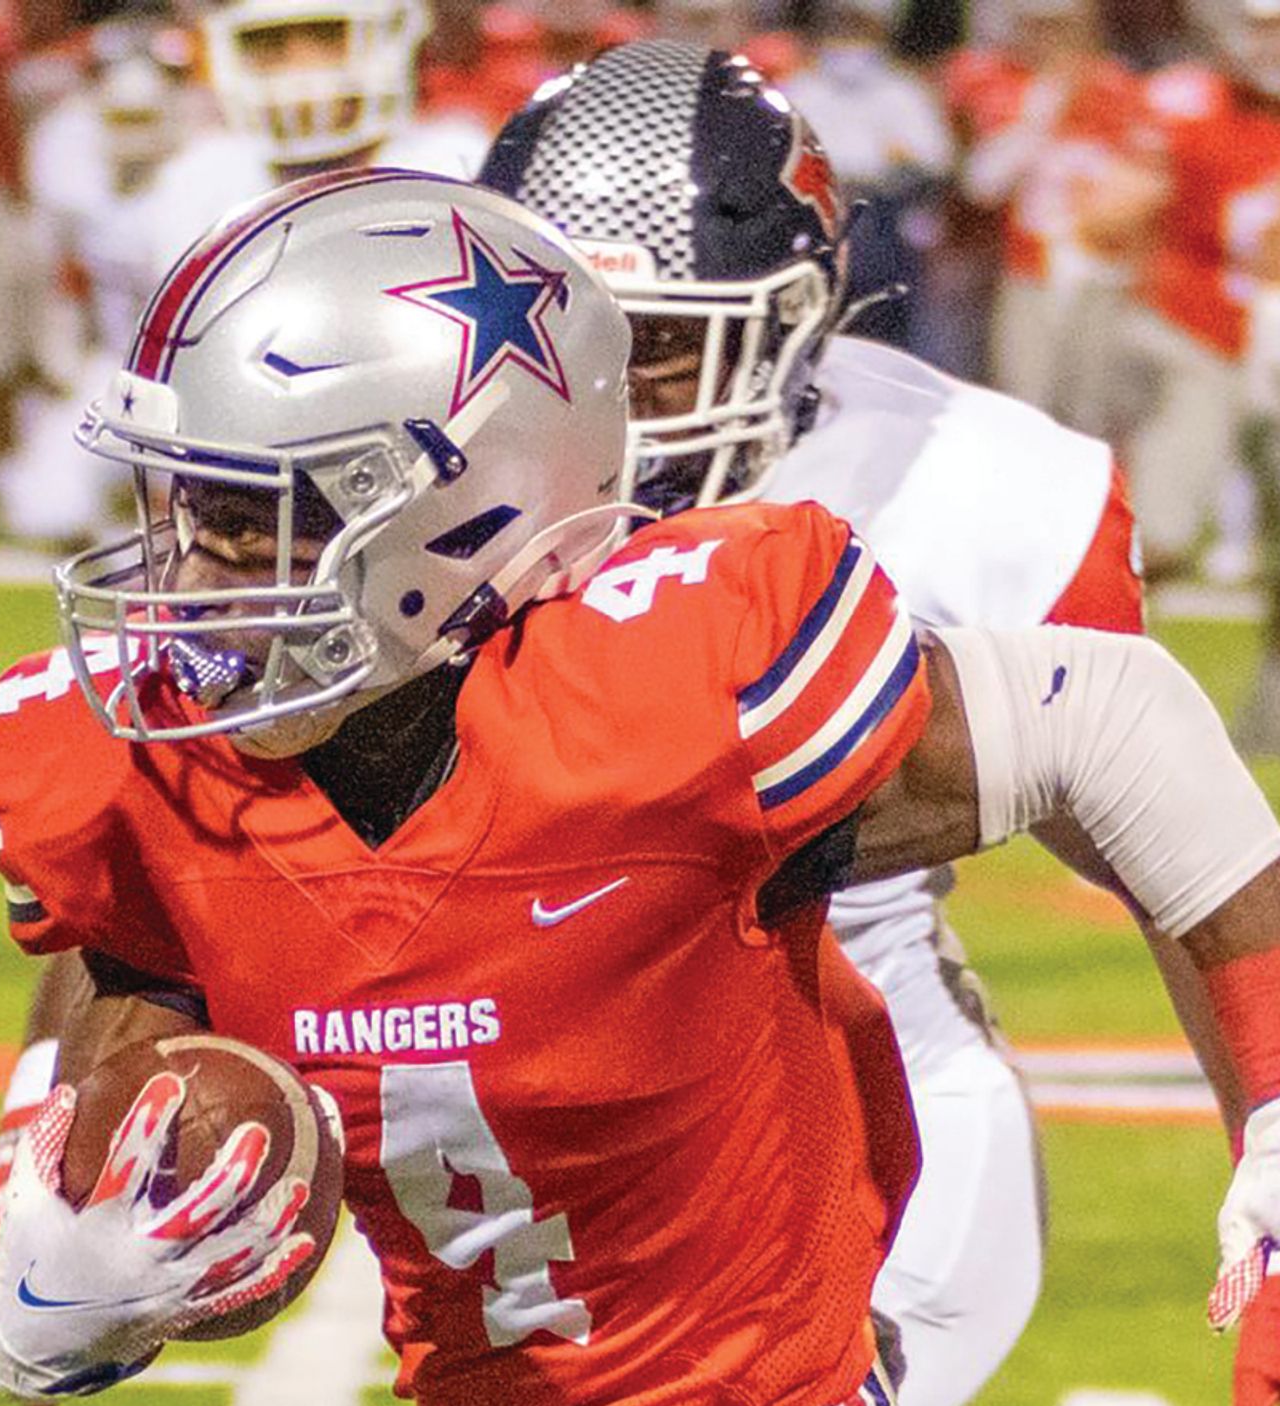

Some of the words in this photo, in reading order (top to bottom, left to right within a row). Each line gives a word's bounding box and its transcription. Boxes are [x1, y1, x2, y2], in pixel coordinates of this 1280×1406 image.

[581, 538, 726, 622] 4
[293, 998, 501, 1053] RANGERS
[380, 1060, 593, 1347] 4
